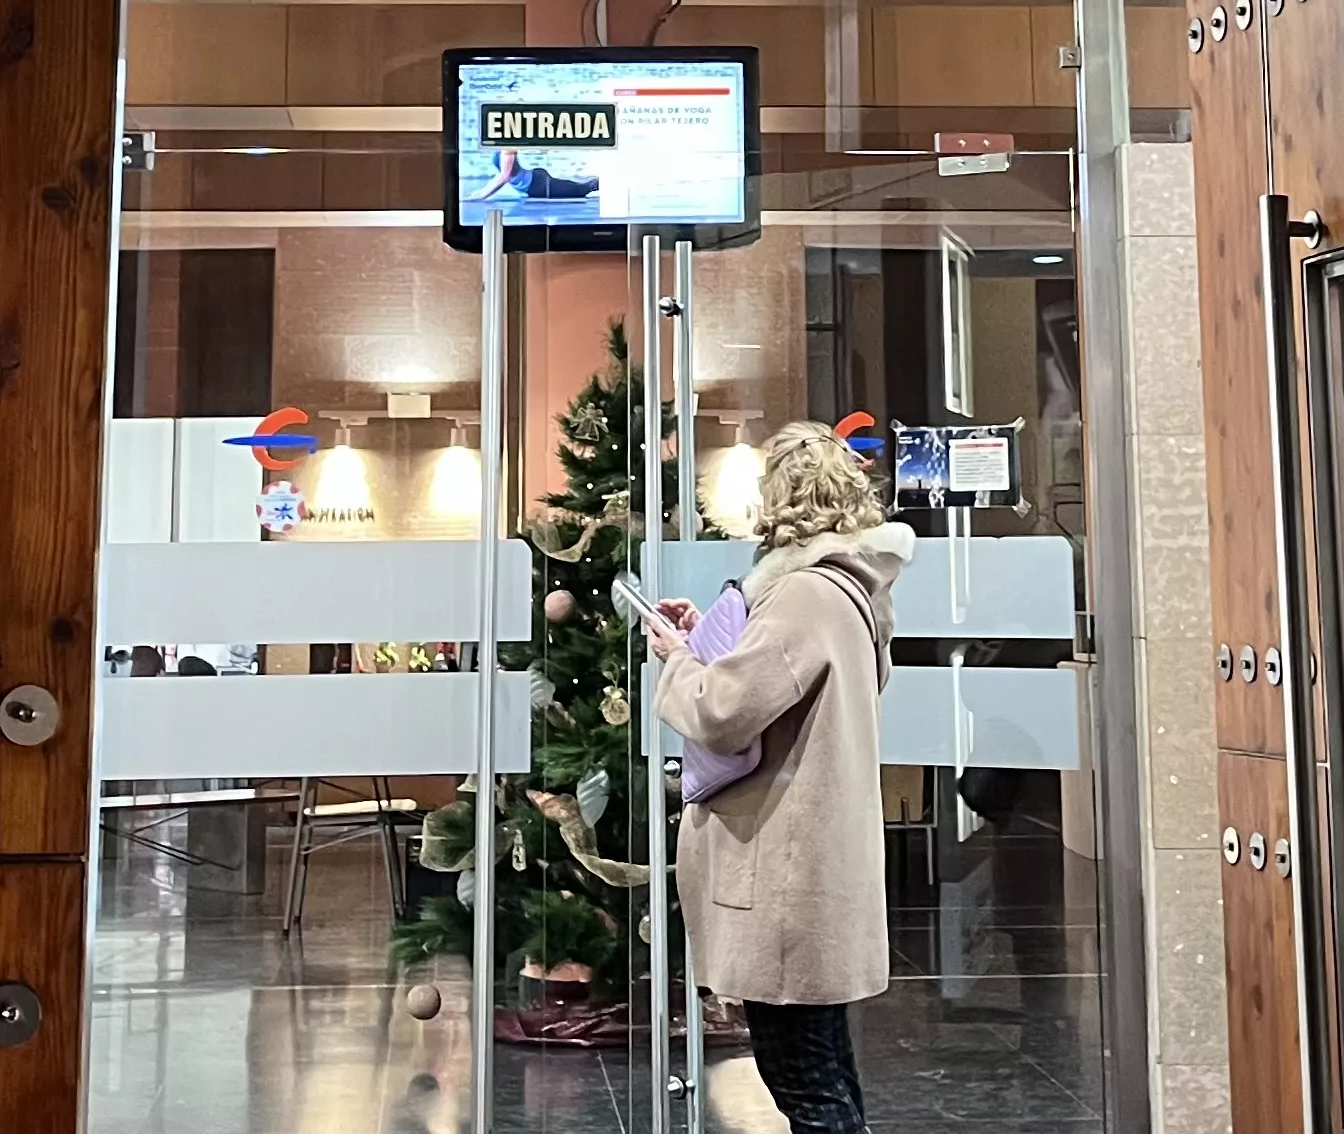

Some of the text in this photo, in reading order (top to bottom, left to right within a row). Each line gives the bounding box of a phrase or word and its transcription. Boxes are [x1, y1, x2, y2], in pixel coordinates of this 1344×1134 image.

[617, 106, 664, 115] AÑANAS
[683, 107, 712, 115] YOGA
[487, 112, 610, 138] ENTRADA
